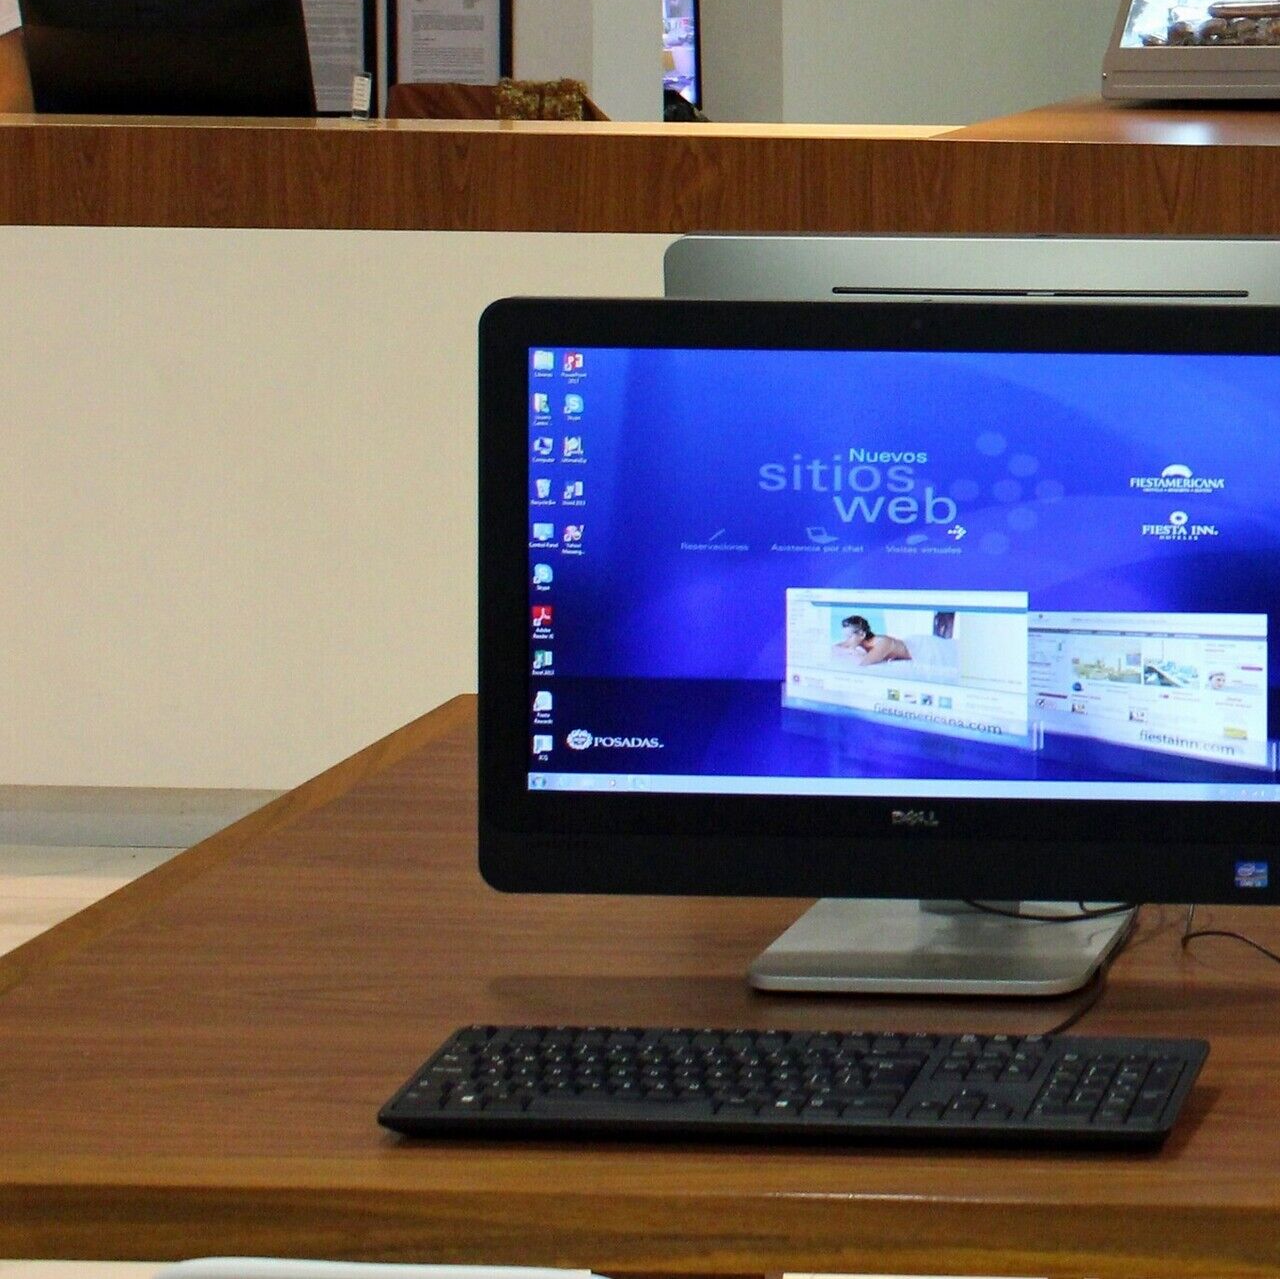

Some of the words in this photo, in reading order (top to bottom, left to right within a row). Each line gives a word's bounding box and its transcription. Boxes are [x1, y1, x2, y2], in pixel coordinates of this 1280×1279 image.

[849, 448, 928, 464] Nuevos
[758, 454, 916, 493] sitios
[832, 487, 957, 525] web
[1141, 525, 1188, 536] FIESTA
[873, 701, 1003, 736] fiestamericana.com
[1138, 728, 1236, 757] fiestainn.com
